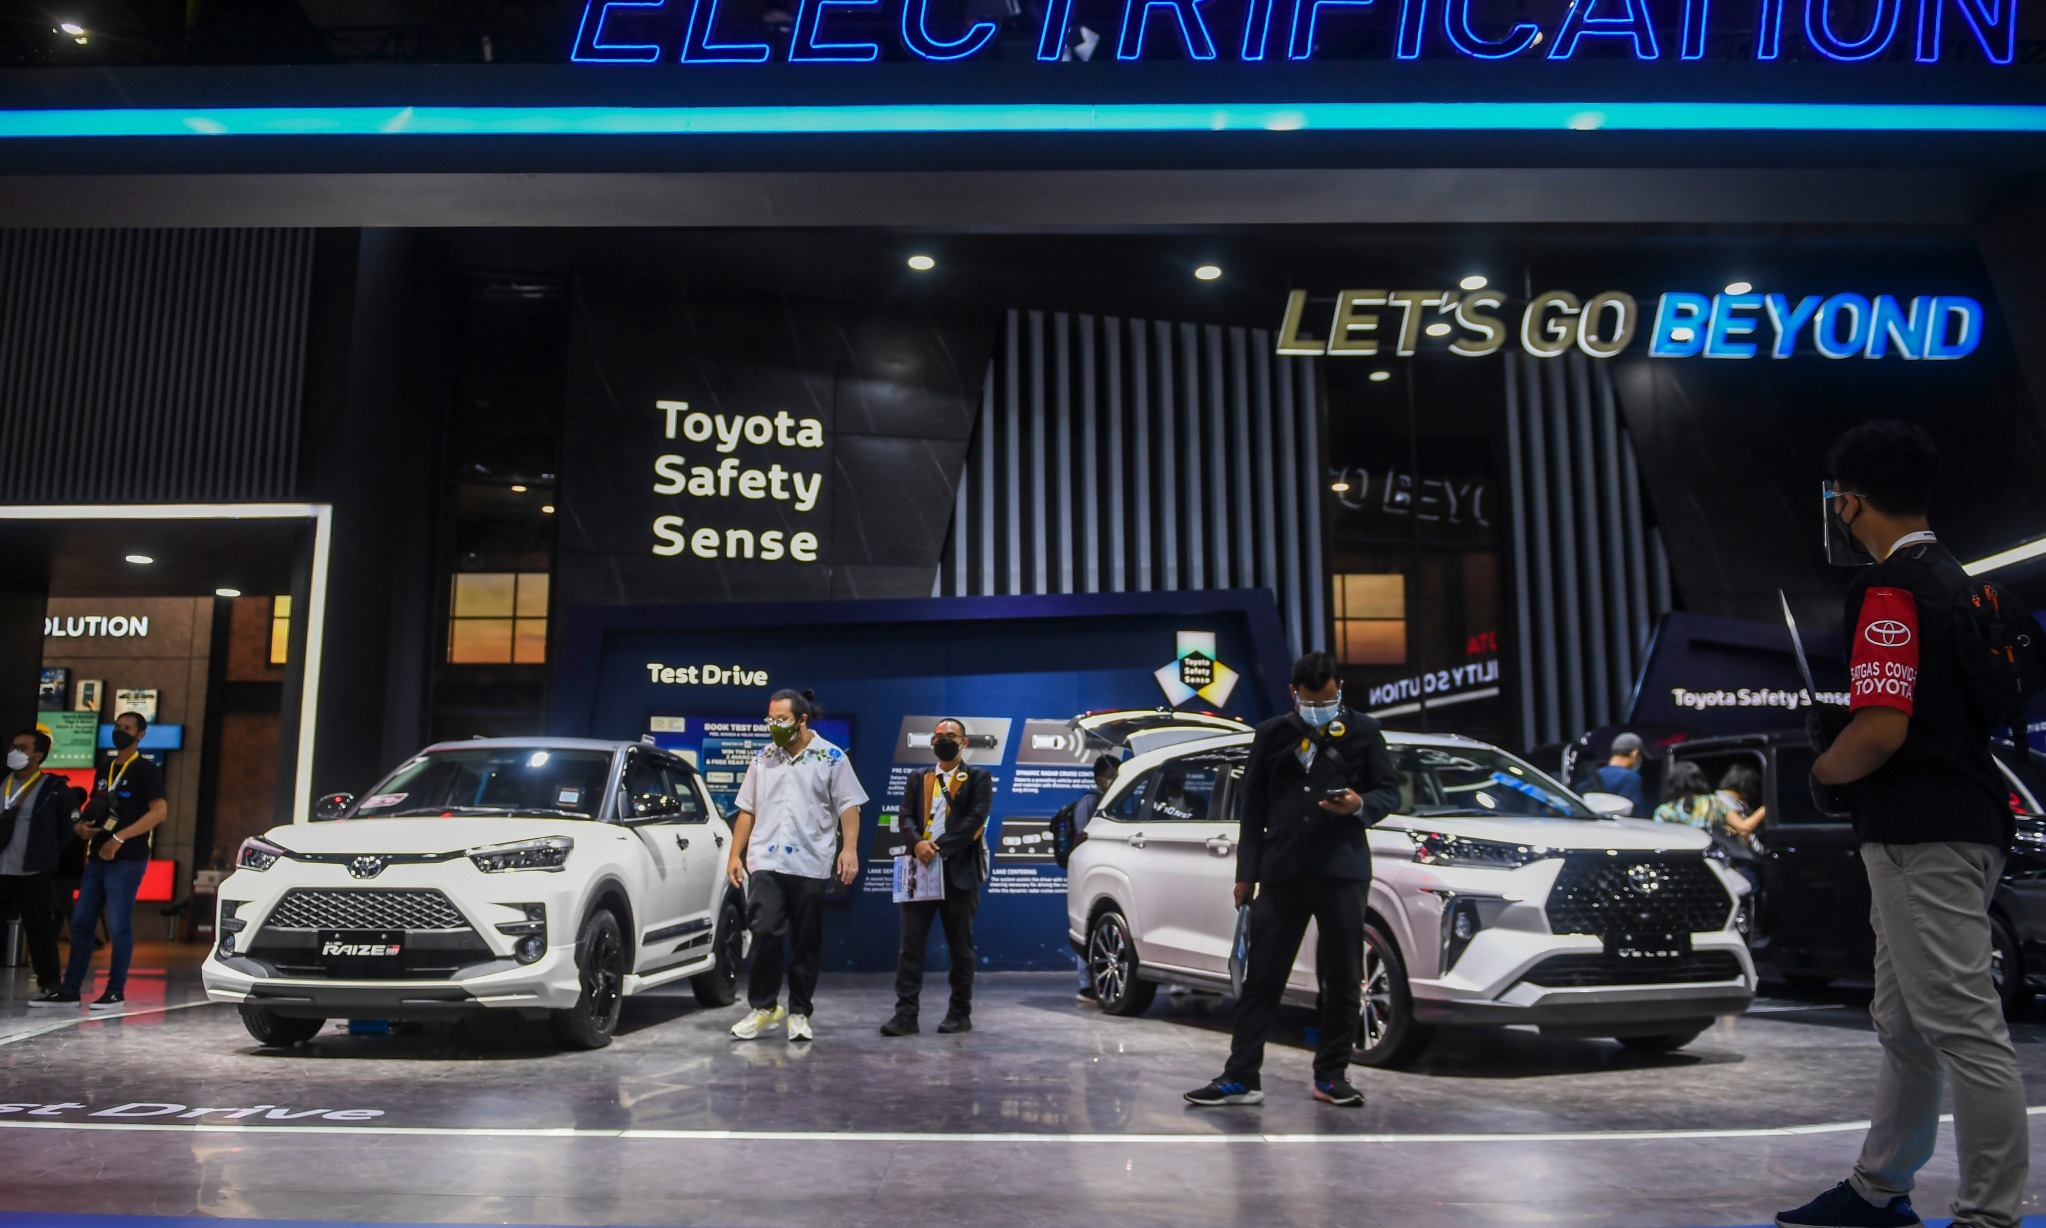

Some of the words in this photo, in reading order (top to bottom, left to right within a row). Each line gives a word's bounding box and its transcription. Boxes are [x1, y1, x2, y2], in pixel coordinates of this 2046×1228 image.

[1276, 288, 1507, 357] LET'S
[1521, 291, 1637, 358] GO
[1649, 292, 1984, 360] BEYOND
[656, 400, 824, 453] Toyota
[653, 454, 822, 512] Safety
[652, 515, 819, 562] Sense
[1184, 657, 1210, 667] Toyota
[1184, 667, 1210, 676] Safety
[1850, 661, 1880, 682] SATGAS
[646, 663, 698, 684] Test
[702, 664, 769, 686] Drive
[1184, 676, 1210, 684] Sense
[1671, 688, 1737, 711] Toyota
[1737, 688, 1799, 710] Safety
[1855, 677, 1914, 702] TOYOTA
[731, 723, 752, 732] TEST
[322, 944, 386, 956] RAIZE
[88, 1102, 386, 1121] Drive
